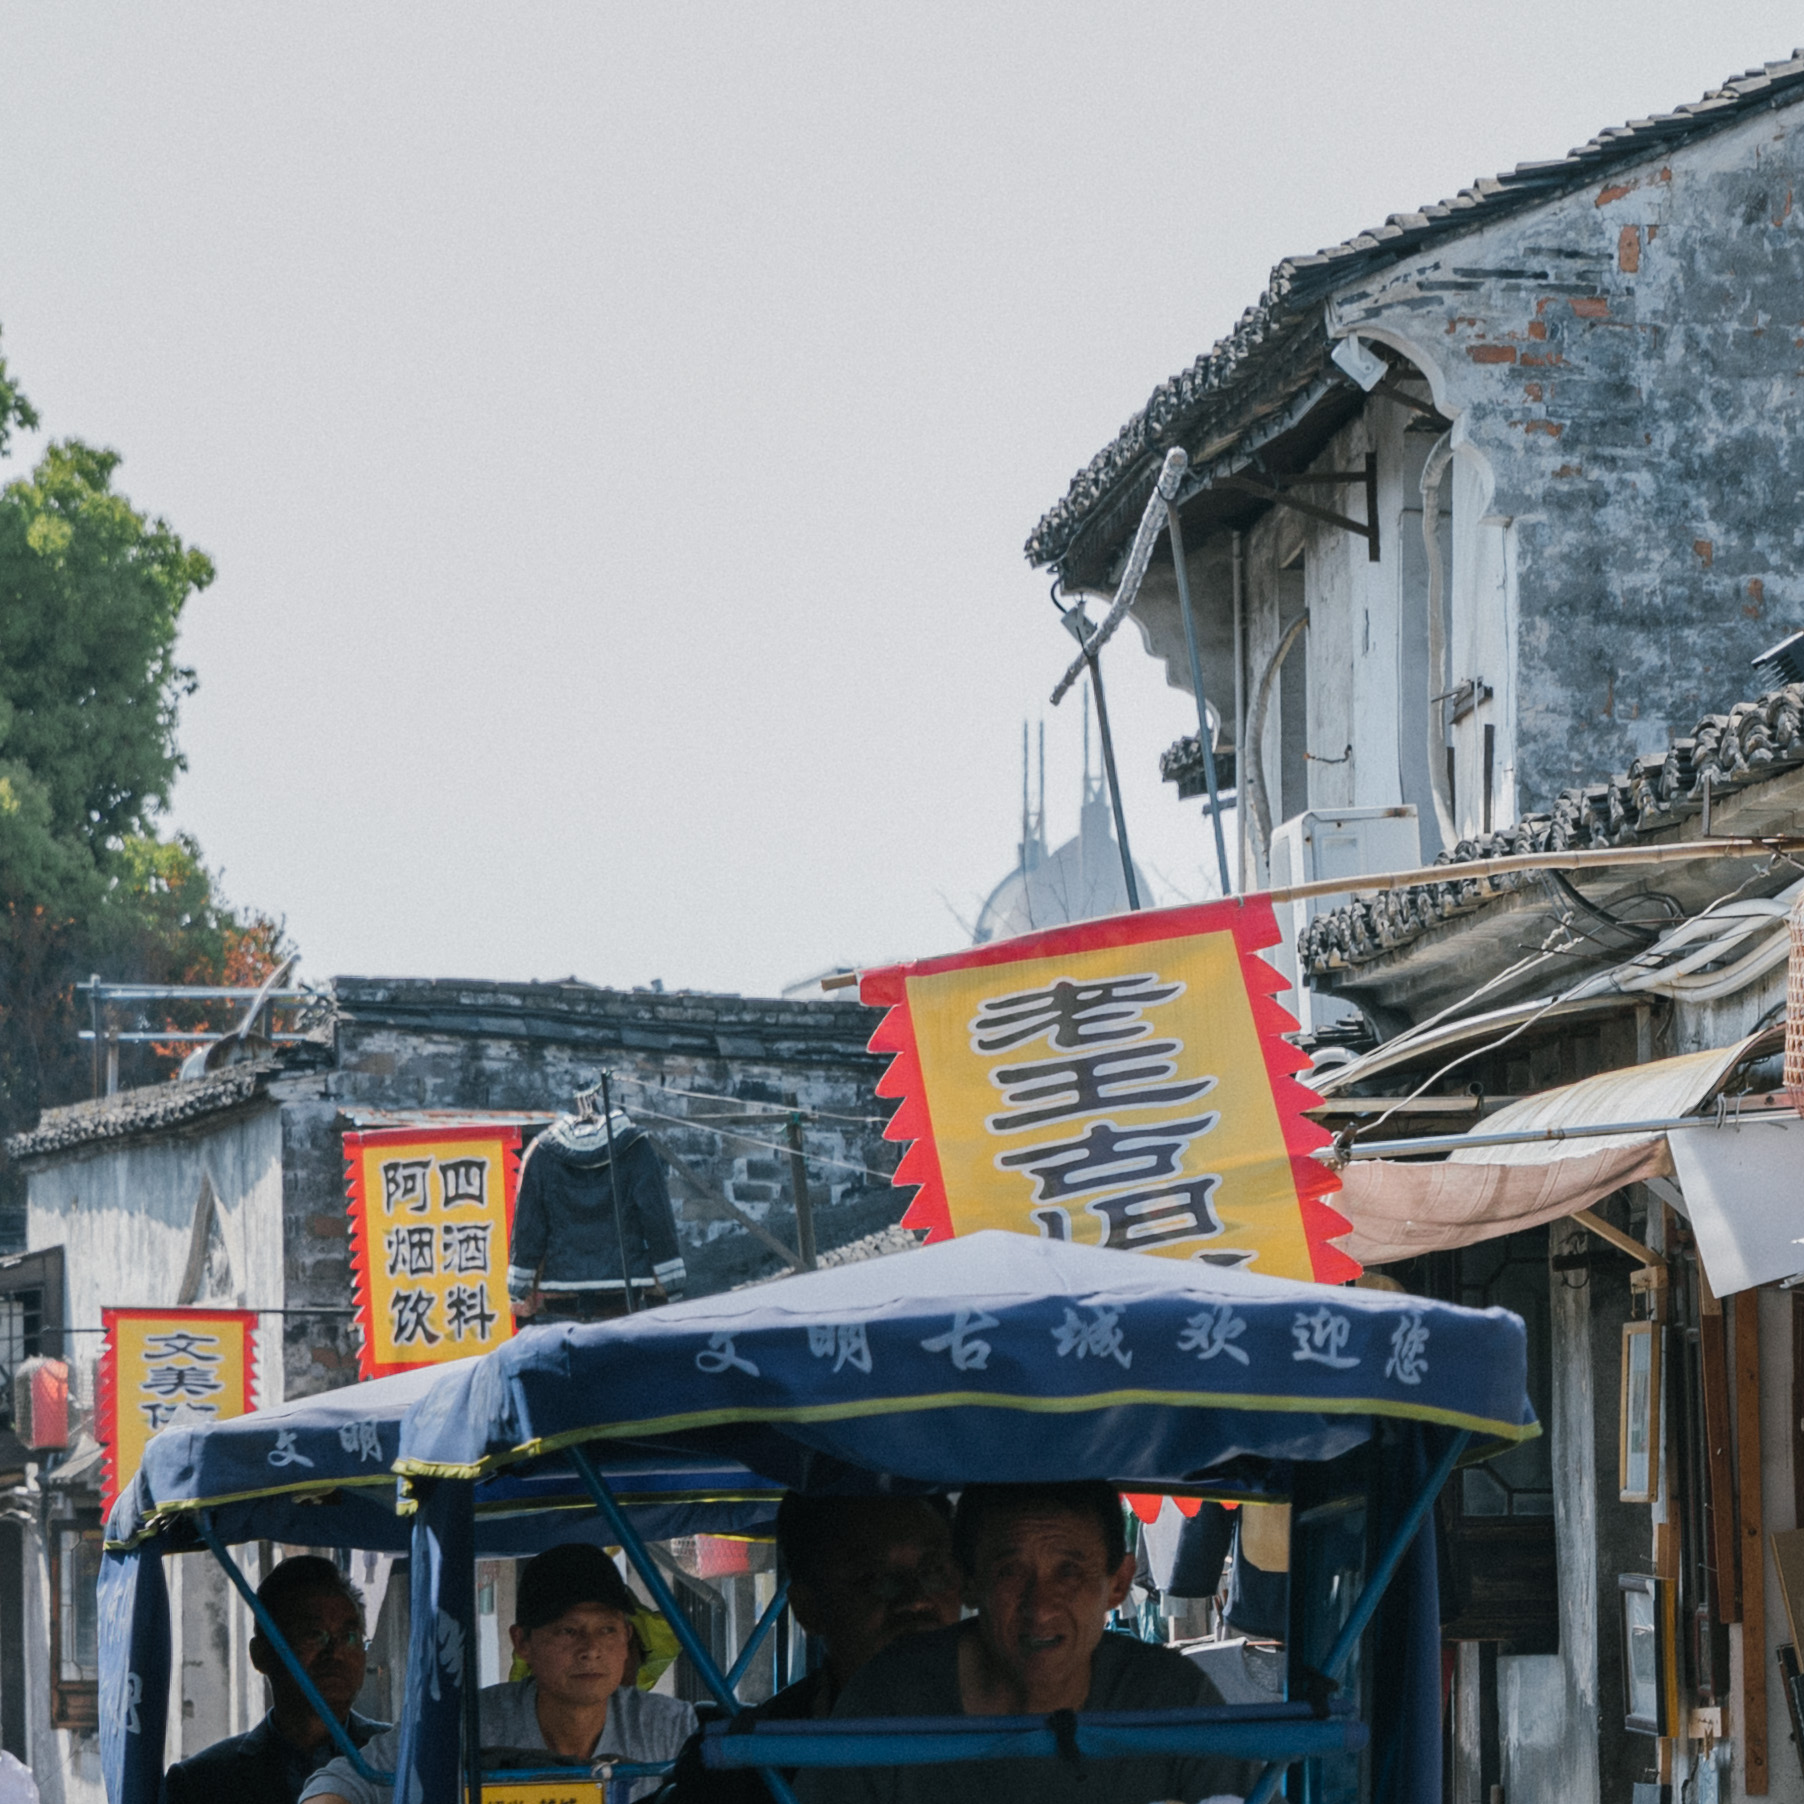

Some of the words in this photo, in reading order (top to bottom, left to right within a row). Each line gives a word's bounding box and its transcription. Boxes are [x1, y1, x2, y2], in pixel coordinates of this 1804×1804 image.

[970, 973, 1256, 1263] 老王古旧
[382, 1157, 488, 1214] 阿四
[387, 1223, 493, 1276] 烟酒
[391, 1283, 497, 1345] 饮料
[695, 1305, 1430, 1387] 文明古城欢迎您
[266, 1415, 384, 1468] 文明
